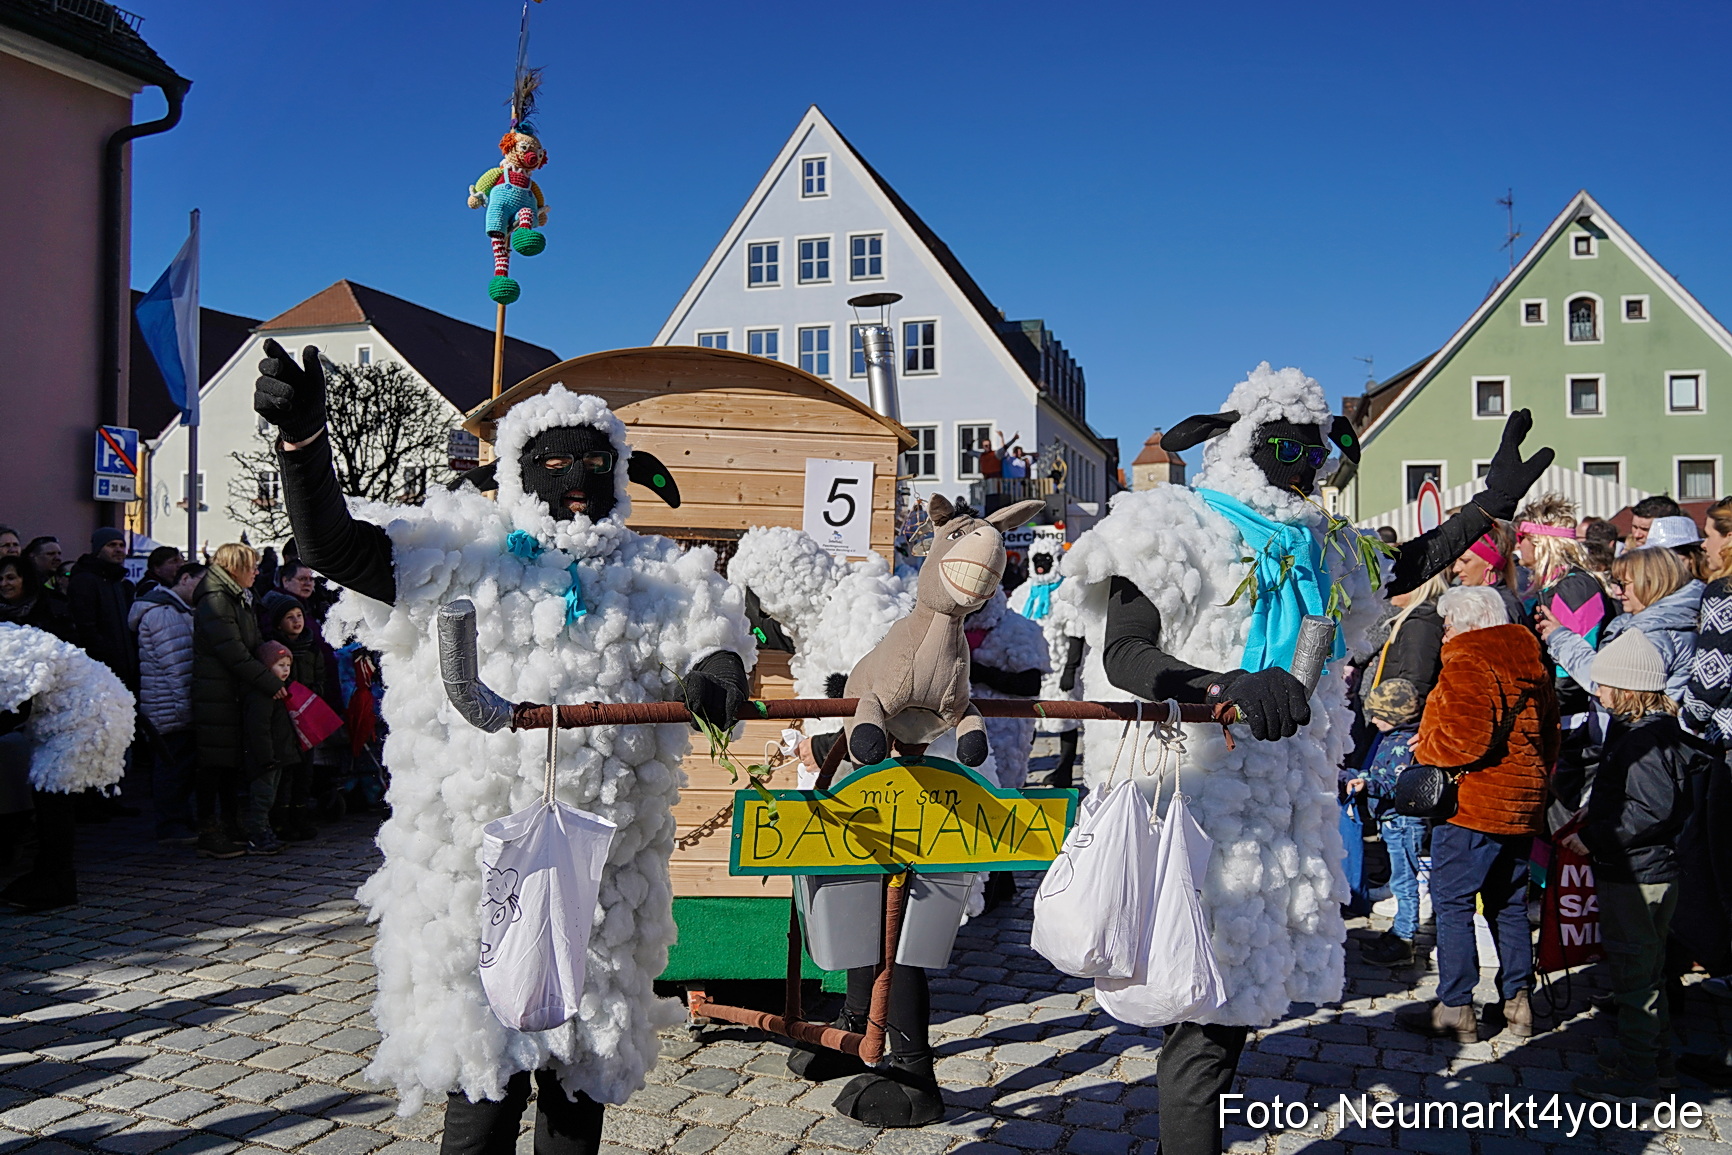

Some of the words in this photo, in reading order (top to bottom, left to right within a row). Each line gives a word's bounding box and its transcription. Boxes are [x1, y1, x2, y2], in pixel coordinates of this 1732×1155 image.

[111, 484, 119, 493] 30
[823, 478, 859, 527] 5
[860, 780, 904, 804] mir
[916, 789, 961, 806] san
[753, 803, 1059, 860] BACHAMA
